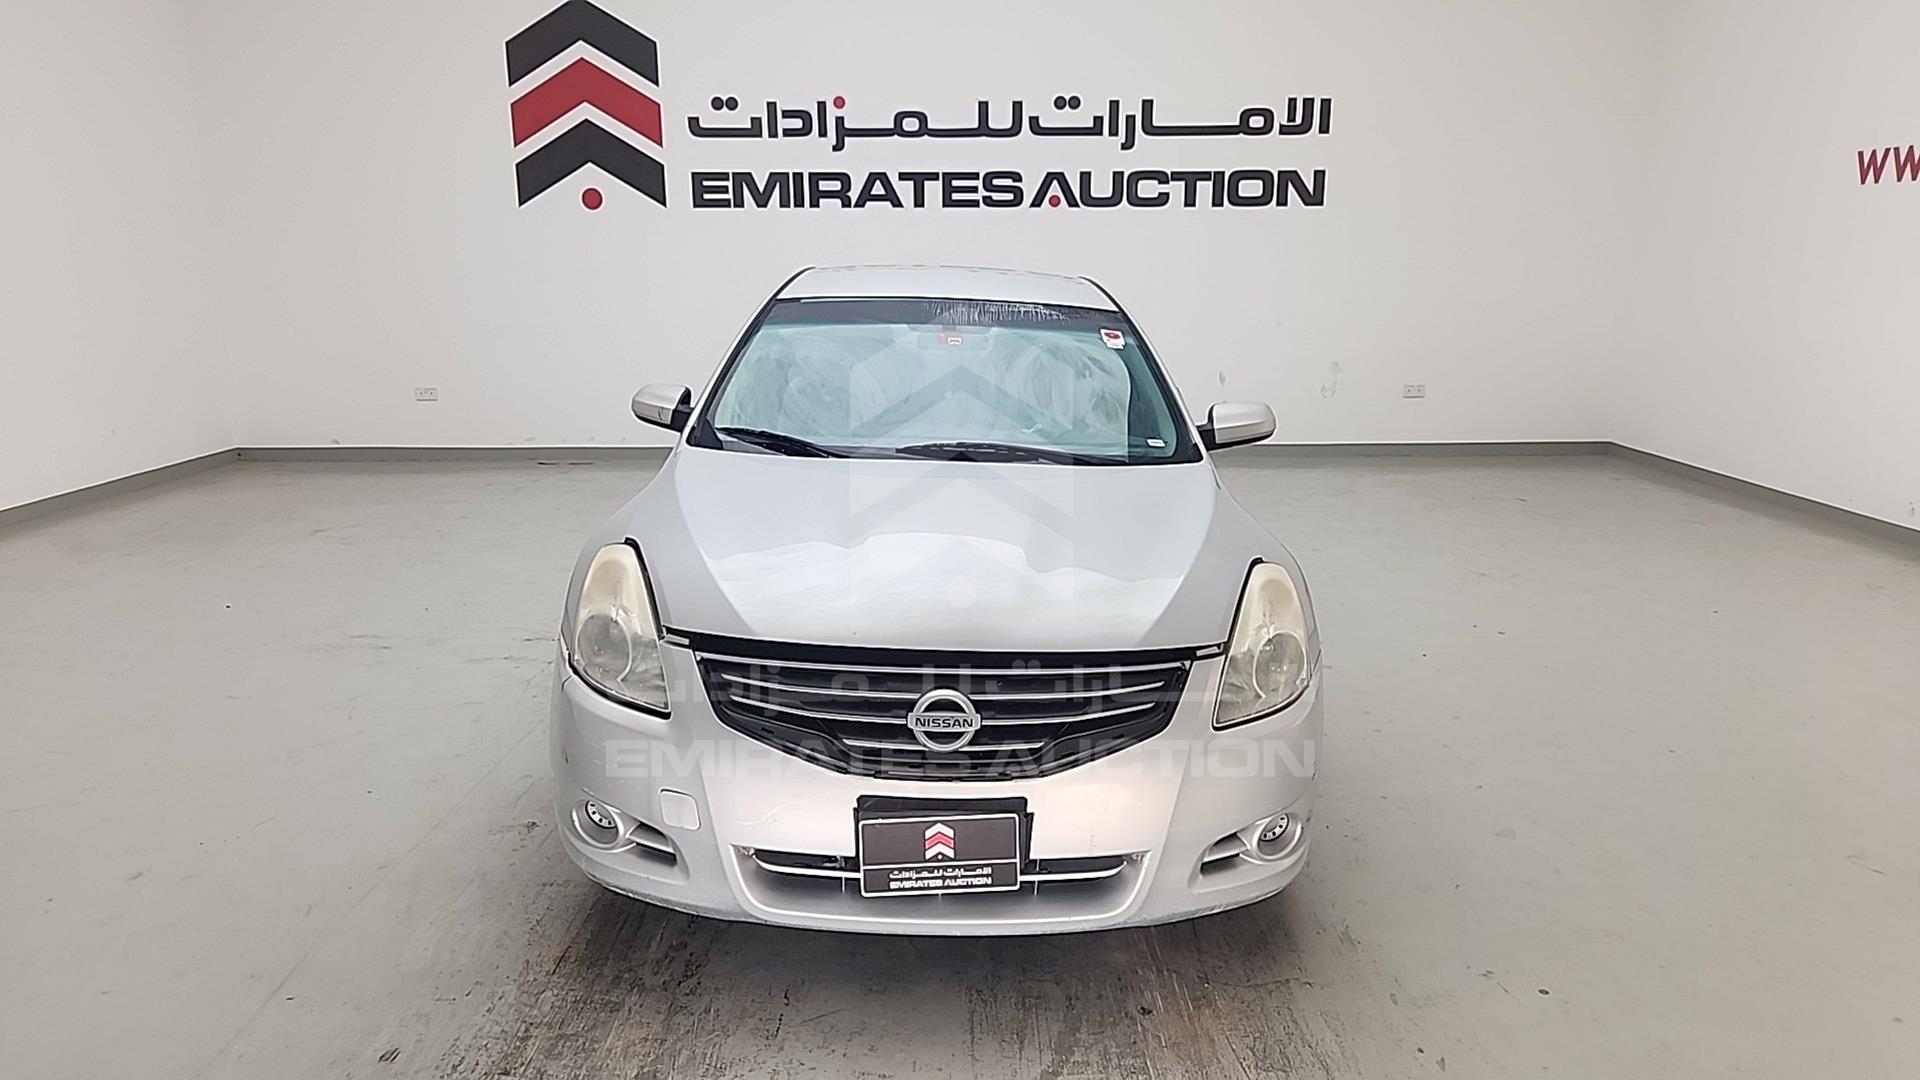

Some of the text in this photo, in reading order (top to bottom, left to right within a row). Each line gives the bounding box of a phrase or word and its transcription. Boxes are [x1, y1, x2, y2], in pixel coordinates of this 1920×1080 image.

[687, 96, 1023, 152] للمزادات
[691, 169, 1326, 208] EMIRATES AUCTION
[915, 717, 973, 728] NISSAN
[889, 876, 992, 889] EMIRATES AUCTION
